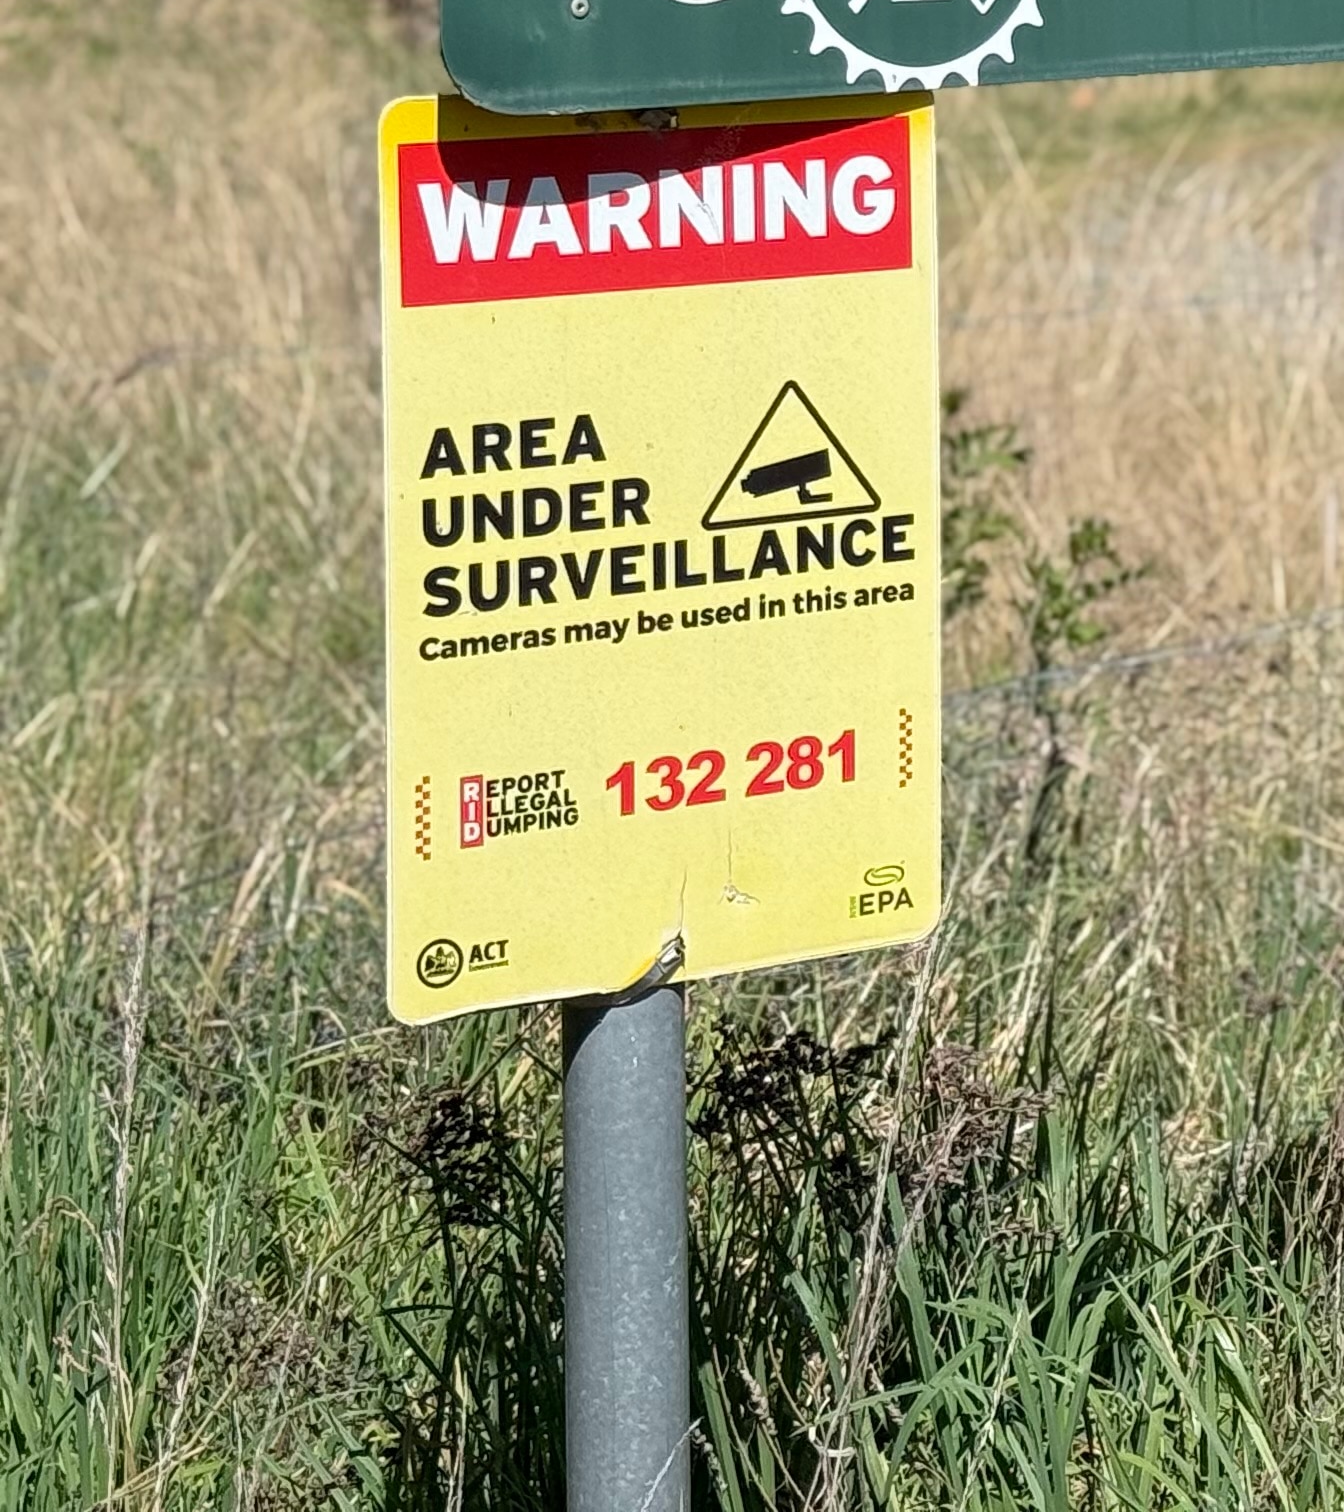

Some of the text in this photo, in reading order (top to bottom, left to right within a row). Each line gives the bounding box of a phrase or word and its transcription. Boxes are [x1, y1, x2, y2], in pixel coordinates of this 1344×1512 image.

[417, 154, 896, 265] WARNING
[419, 414, 607, 480] AREA
[421, 477, 651, 548] UNDER
[421, 513, 916, 618] SURVEILLANCE
[419, 580, 916, 662] Cameras may be used in this area
[604, 751, 727, 817] 132
[745, 729, 857, 799] 281
[859, 886, 914, 917] EPA
[469, 939, 510, 963] ACT
